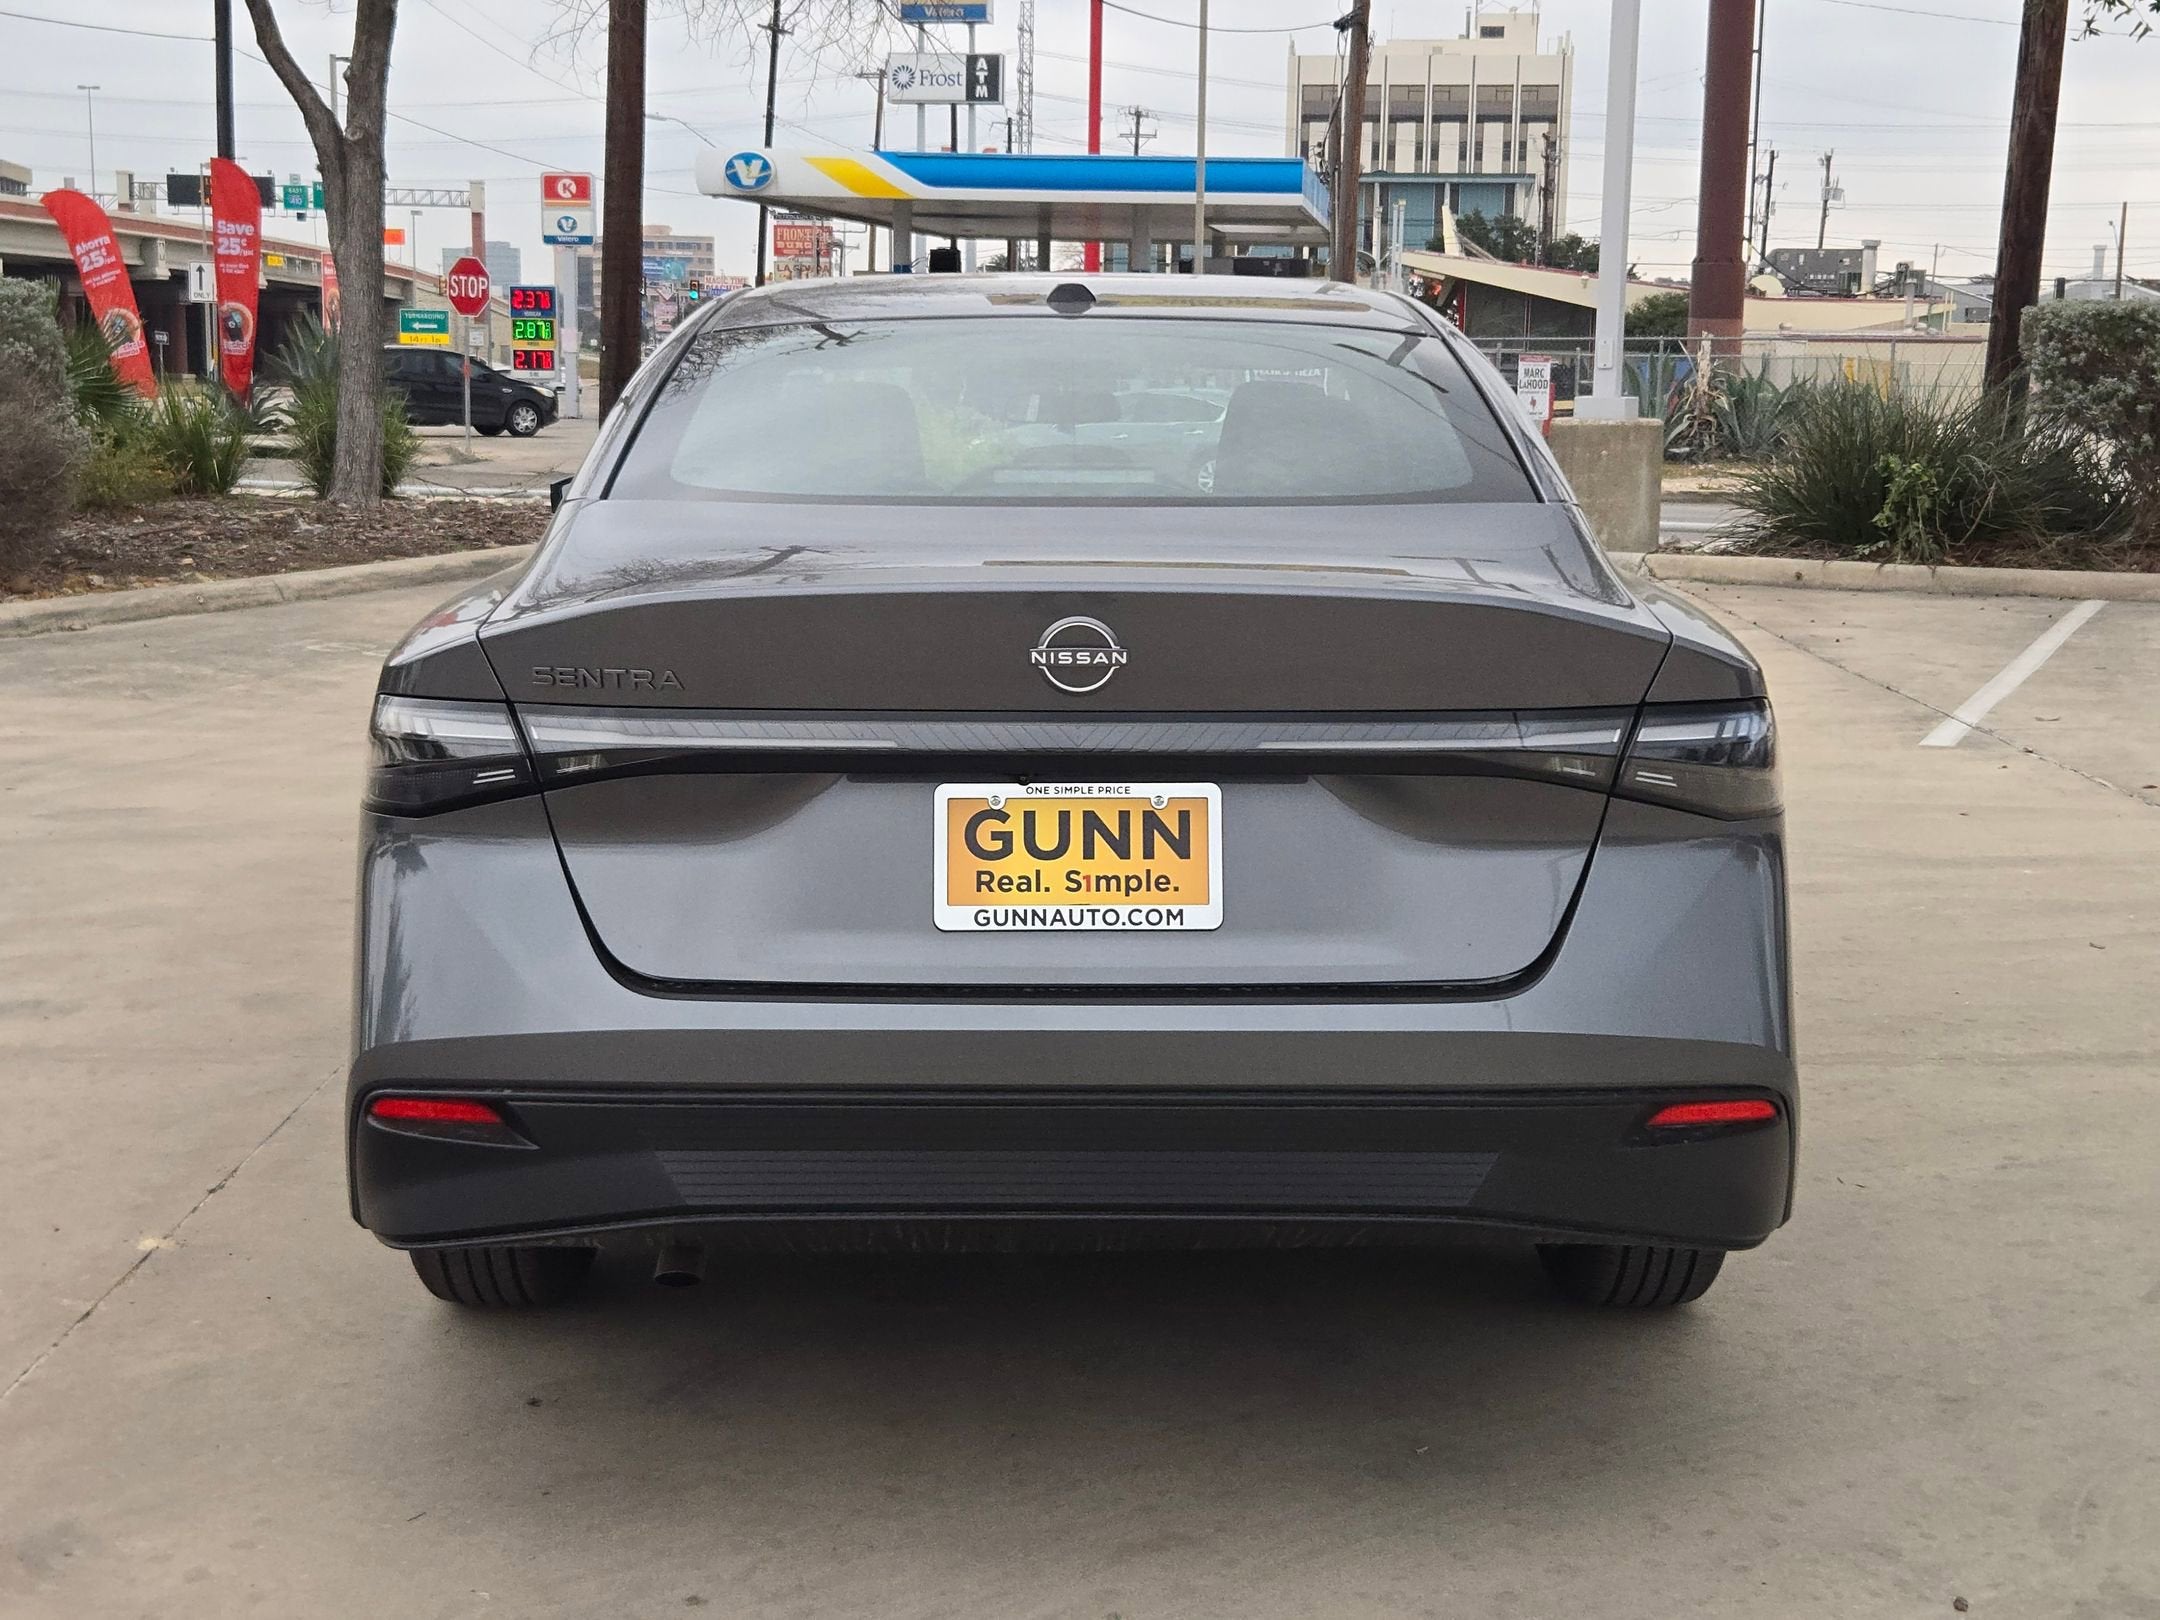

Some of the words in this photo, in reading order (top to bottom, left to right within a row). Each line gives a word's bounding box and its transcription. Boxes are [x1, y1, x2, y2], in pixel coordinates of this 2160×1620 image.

[923, 6, 965, 17] Valero
[919, 69, 963, 87] Frost
[975, 57, 989, 98] ATM
[560, 180, 576, 198] K
[217, 220, 254, 236] Save
[75, 235, 111, 256] Ahorra
[193, 291, 210, 299] ONLY
[450, 275, 488, 298] STOP
[1523, 367, 1545, 378] MARC
[1031, 651, 1128, 664] NISSAN
[532, 666, 686, 691] SENTRA
[1026, 786, 1050, 795] ONE
[1053, 786, 1094, 795] SIMPLE
[1098, 786, 1131, 795] PRICE
[964, 808, 1191, 861] GUNN
[975, 869, 1050, 893] Real.
[974, 908, 1184, 927] GUNNAUTO.COM
